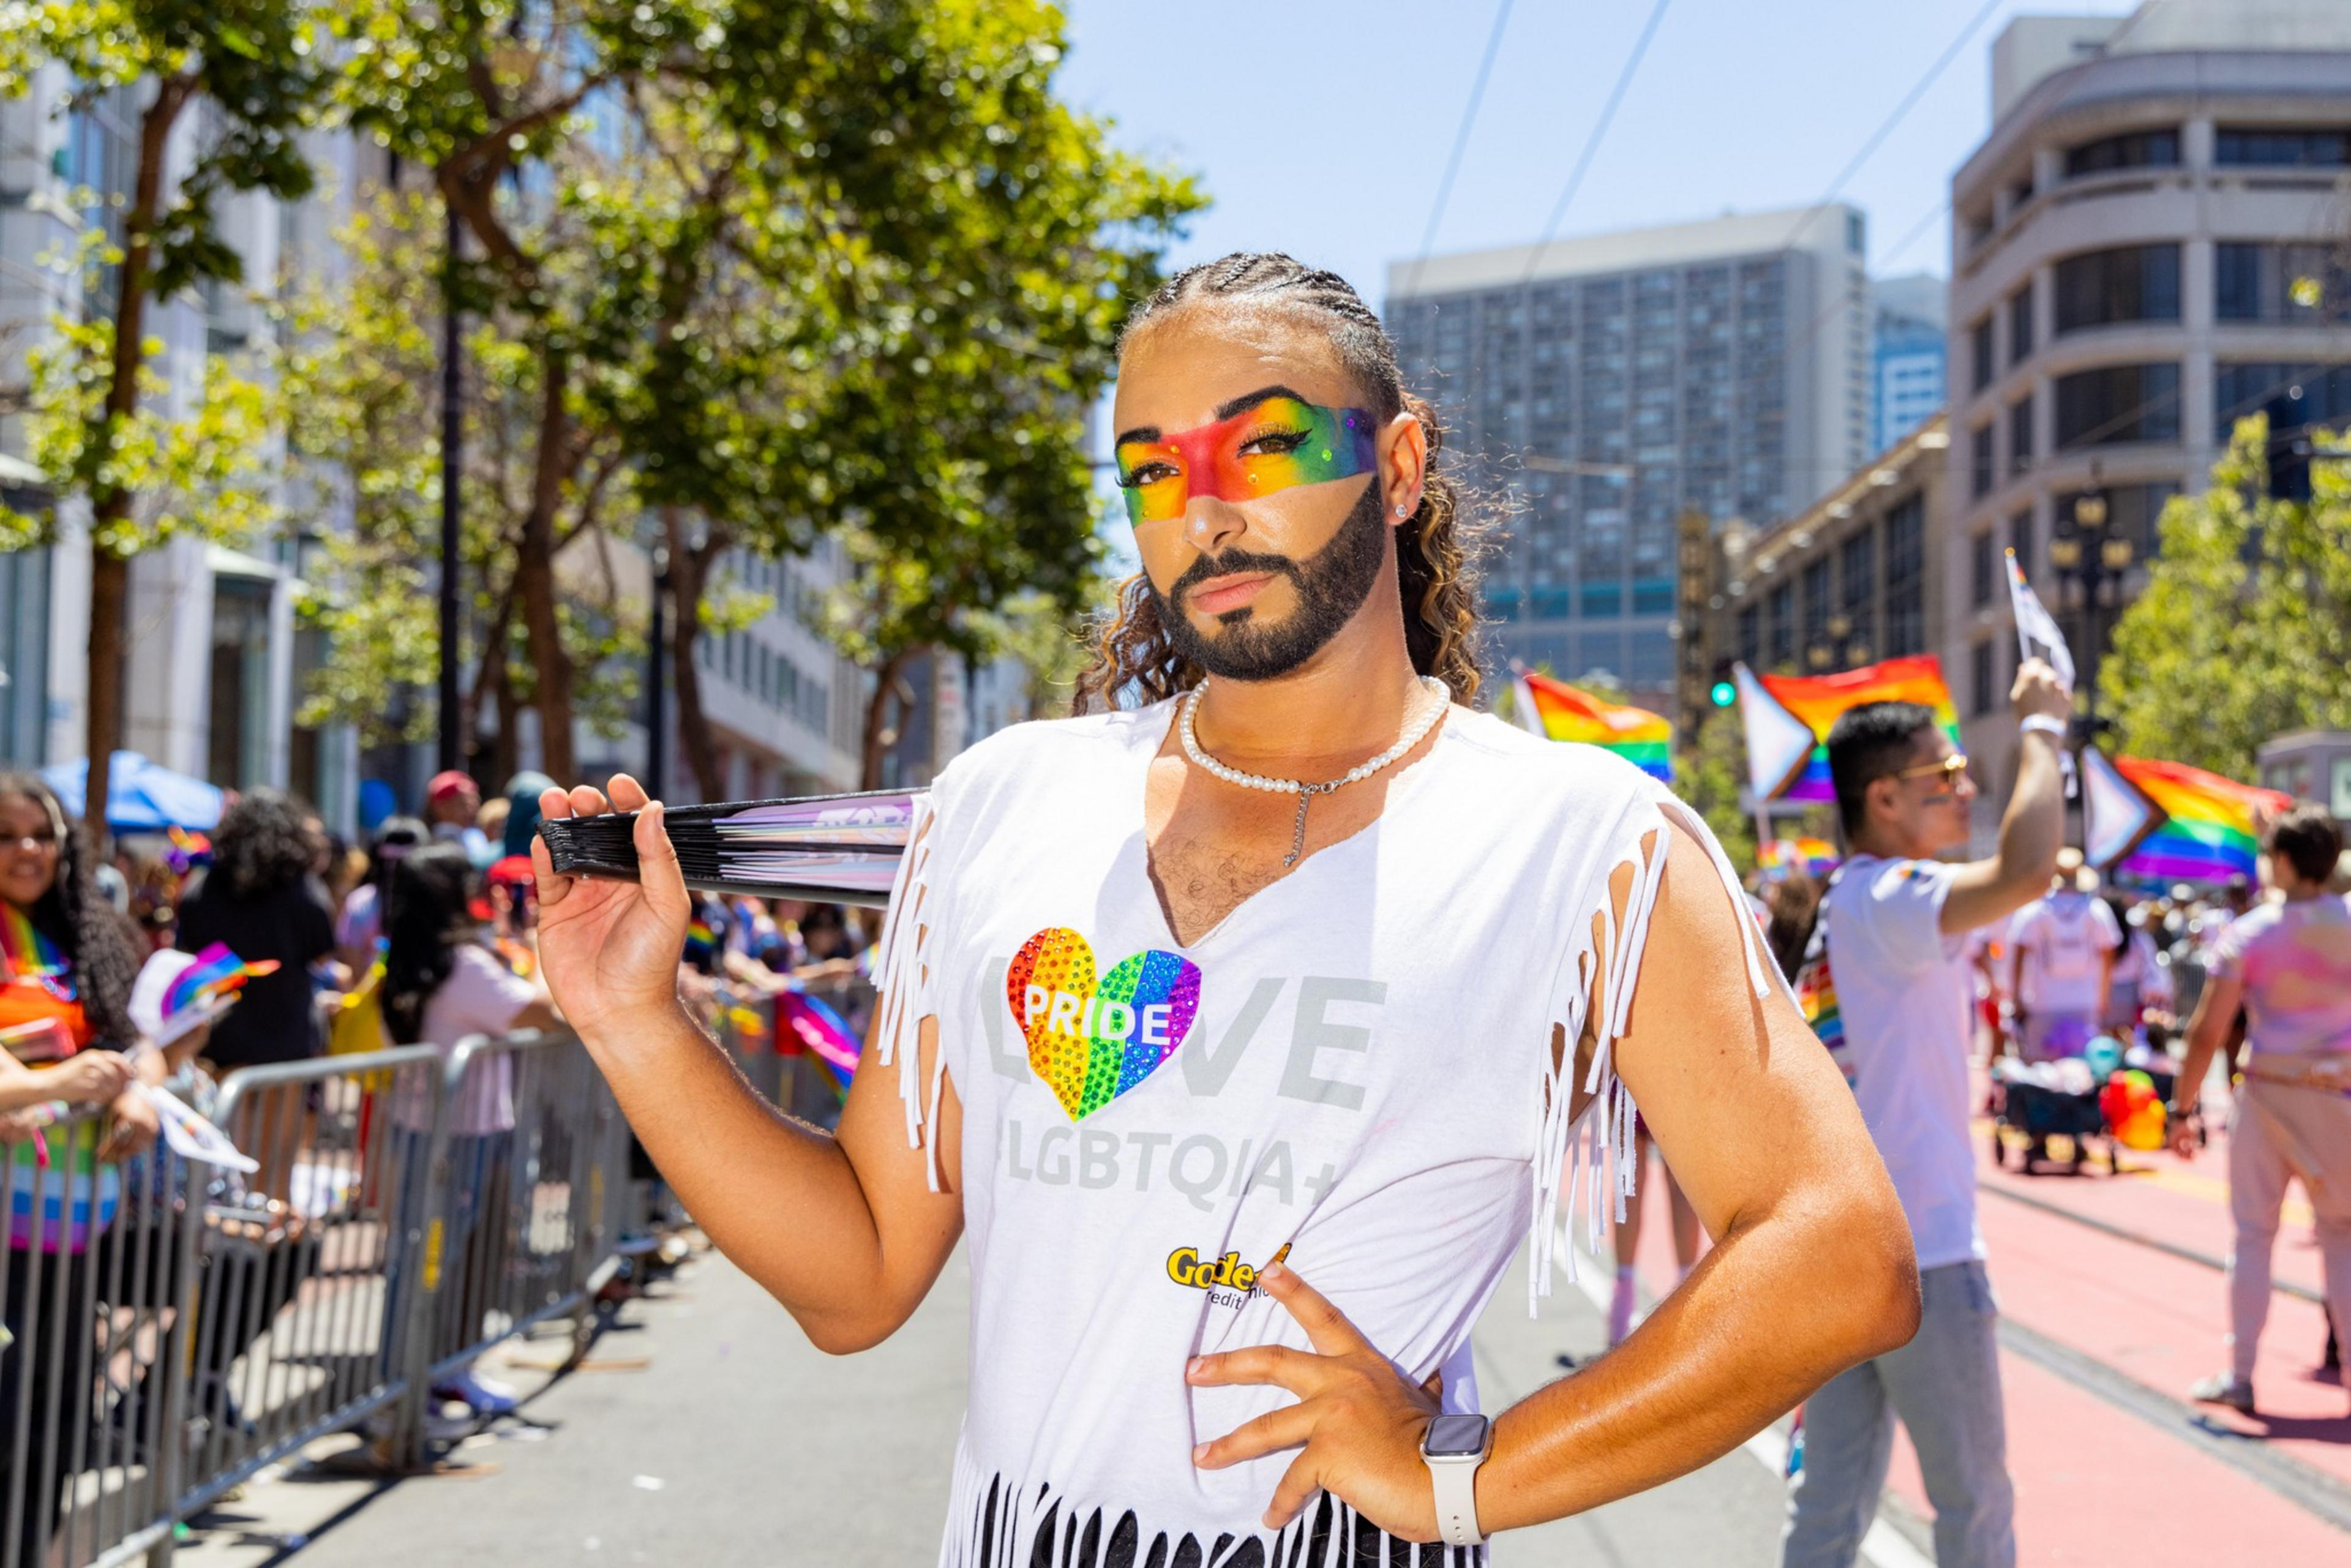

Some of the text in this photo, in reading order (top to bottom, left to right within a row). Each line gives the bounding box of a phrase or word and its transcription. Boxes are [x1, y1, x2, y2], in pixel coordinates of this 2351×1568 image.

[1024, 984, 1172, 1045] PRIDE
[1009, 1120, 1340, 1213] LGBTQIA+
[1207, 1291, 1242, 1310] redit
